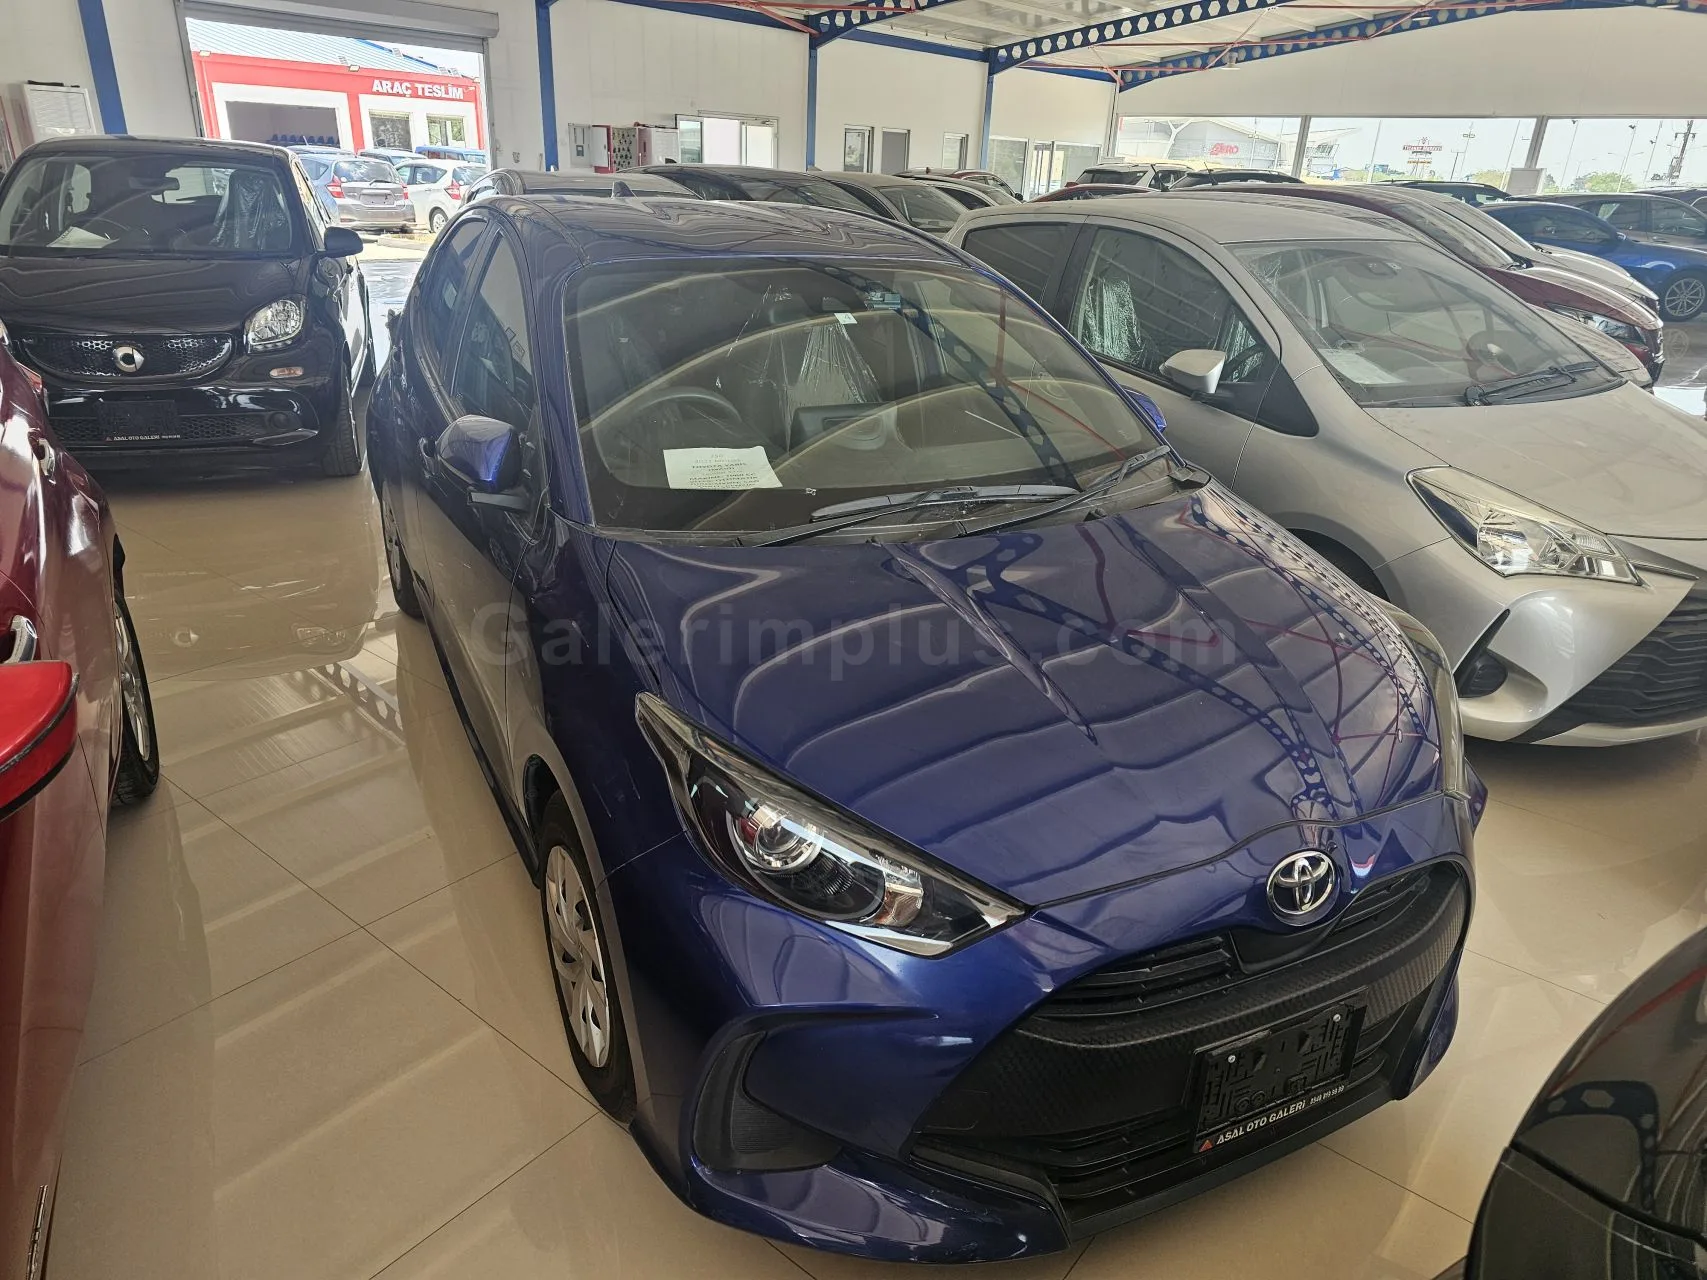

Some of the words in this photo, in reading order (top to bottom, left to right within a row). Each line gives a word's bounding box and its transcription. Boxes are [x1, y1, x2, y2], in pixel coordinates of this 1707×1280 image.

[372, 80, 412, 97] ARAÇ
[415, 84, 464, 99] TESLİM
[1216, 1130, 1245, 1145] ASAL
[1246, 1118, 1267, 1132] OTO
